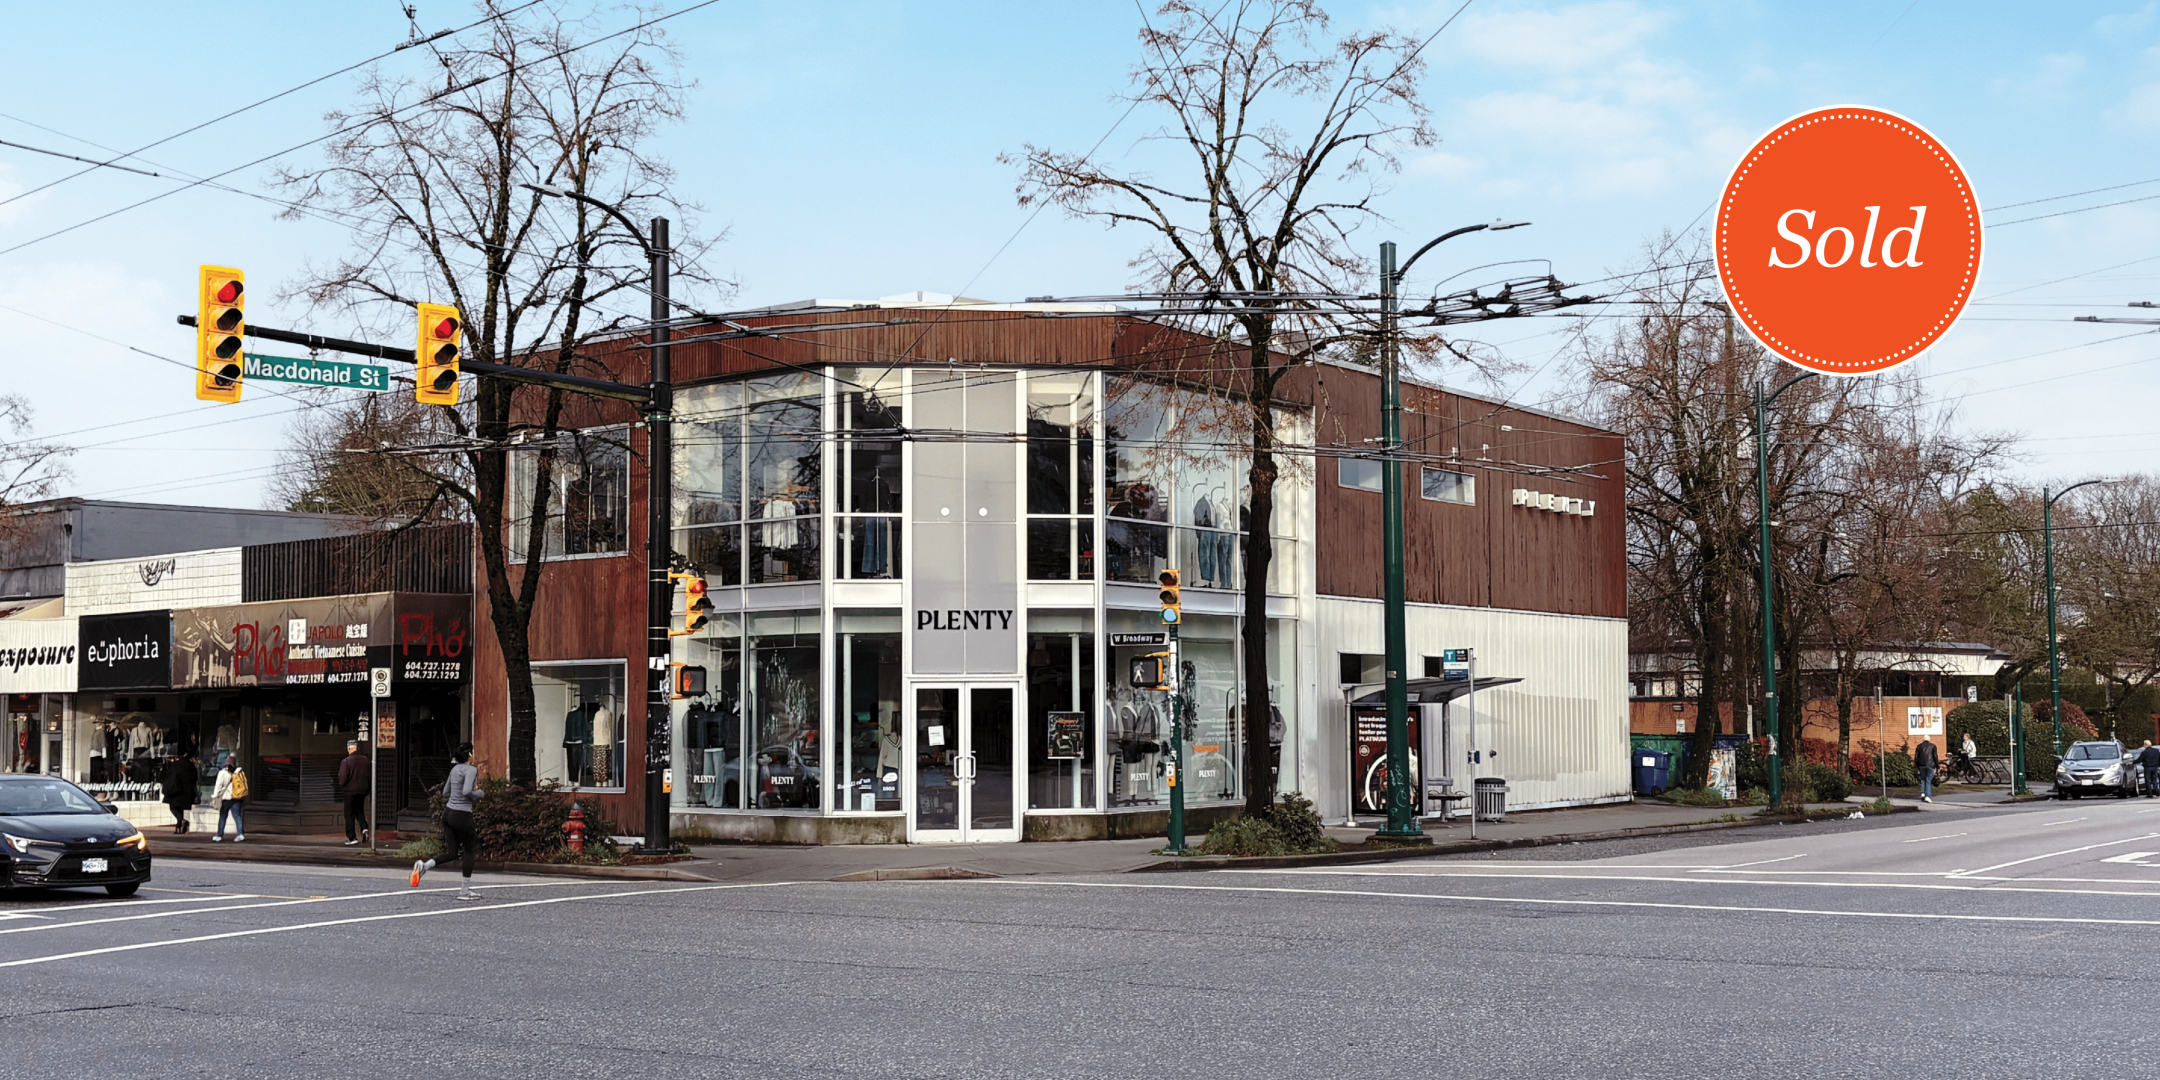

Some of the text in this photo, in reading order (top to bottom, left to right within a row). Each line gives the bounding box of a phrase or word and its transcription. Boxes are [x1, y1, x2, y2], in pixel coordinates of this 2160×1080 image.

[244, 357, 380, 386] Macdonald St
[1512, 488, 1596, 516] PLENTY
[917, 610, 1013, 630] PLENTY
[308, 625, 344, 640] JAPOLO
[1122, 634, 1153, 643] Broadway
[314, 644, 346, 658] Vietnamese
[345, 642, 367, 657] Cuisine
[405, 661, 461, 671] 604.737.1278
[404, 670, 460, 679] 604.737.1293
[1910, 714, 1932, 728] VPL
[1130, 772, 1149, 781] PLENTY
[1198, 769, 1216, 778] PLENTY
[693, 774, 716, 784] PLENTY
[771, 776, 794, 785] PLENTY
